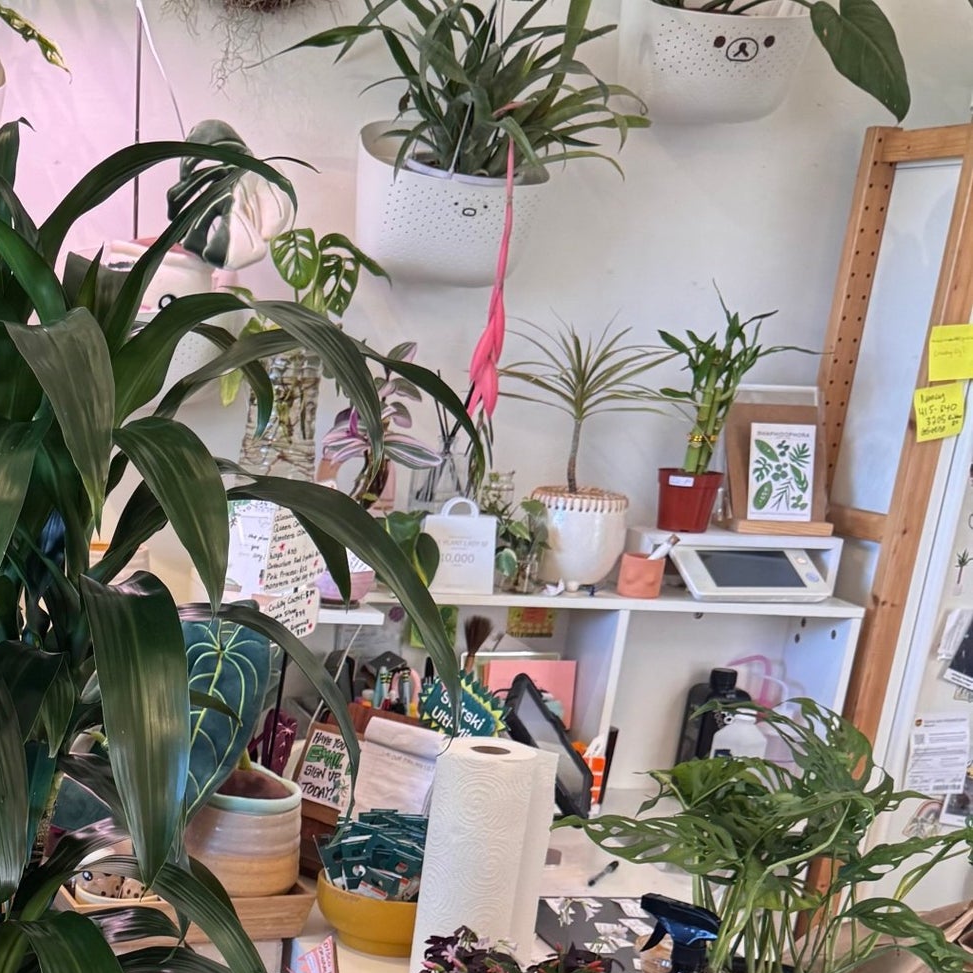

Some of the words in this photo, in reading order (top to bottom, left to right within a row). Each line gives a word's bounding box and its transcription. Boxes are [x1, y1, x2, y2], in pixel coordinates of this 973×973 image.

[312, 732, 332, 746] HAVE
[303, 765, 326, 780] SIGN
[328, 770, 342, 782] UP
[301, 781, 336, 800] TODAY!
